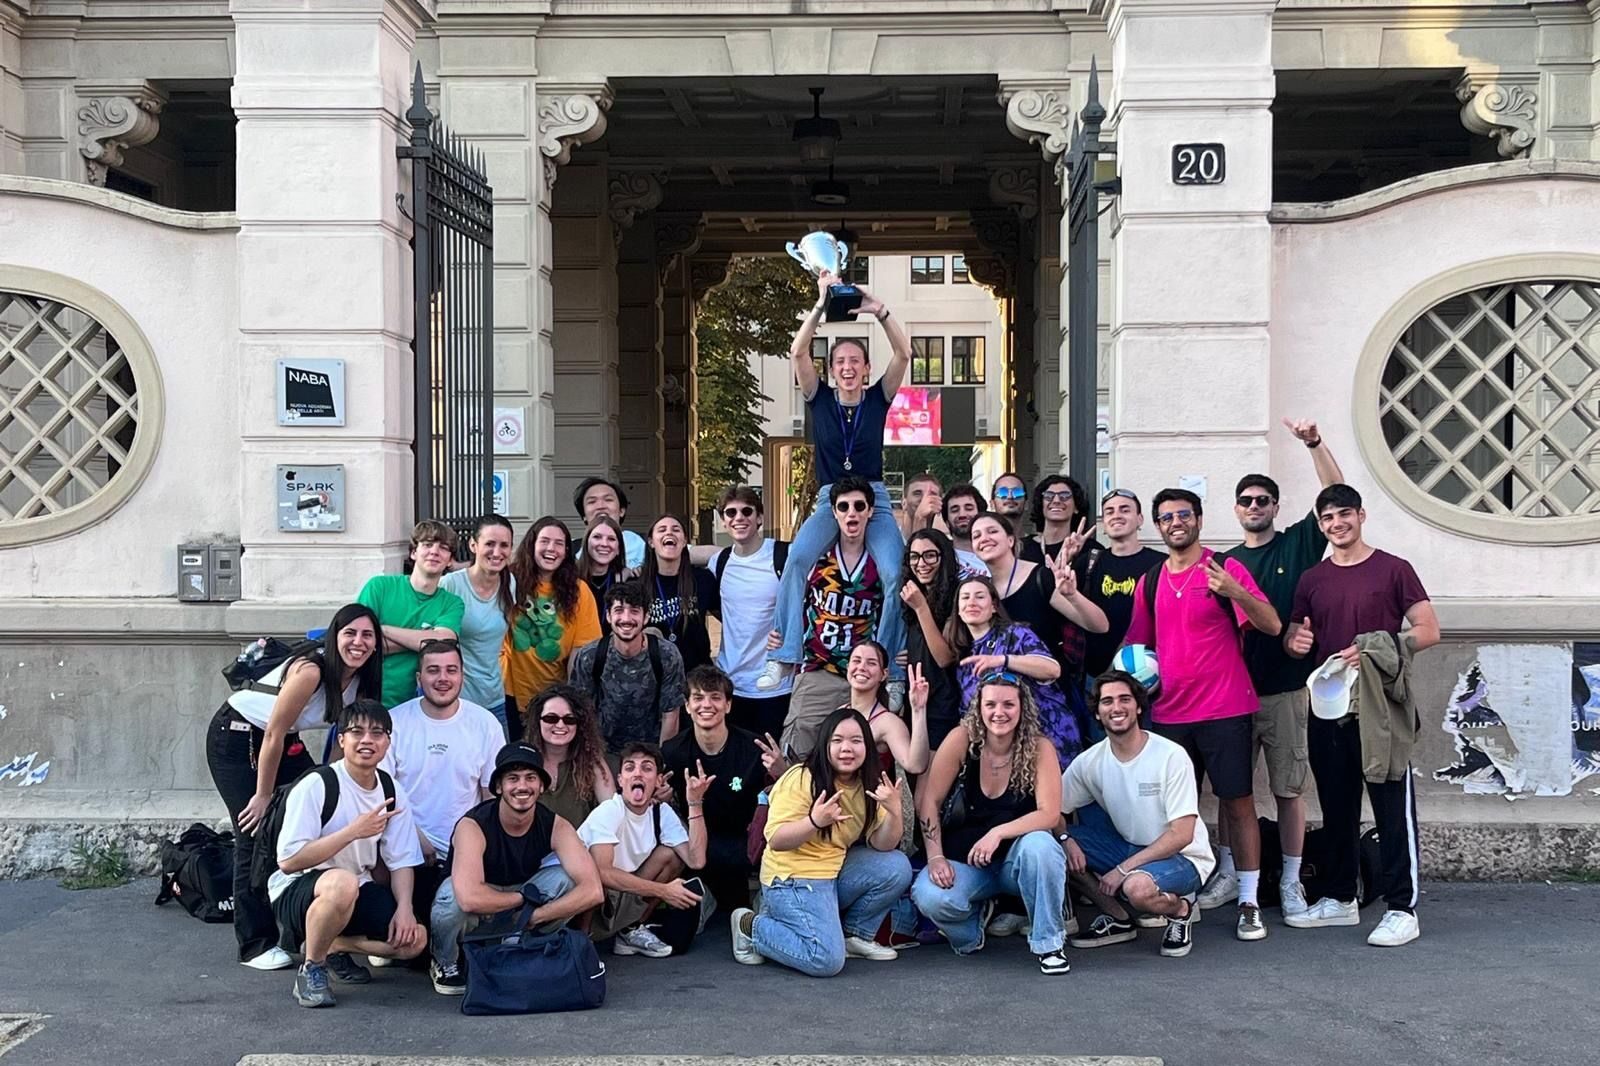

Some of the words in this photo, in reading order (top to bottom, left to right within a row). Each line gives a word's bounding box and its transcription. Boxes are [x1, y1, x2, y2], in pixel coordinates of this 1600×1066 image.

[1177, 148, 1219, 179] 20
[289, 370, 328, 387] NABA
[286, 482, 335, 491] SPARK
[820, 620, 854, 652] 81
